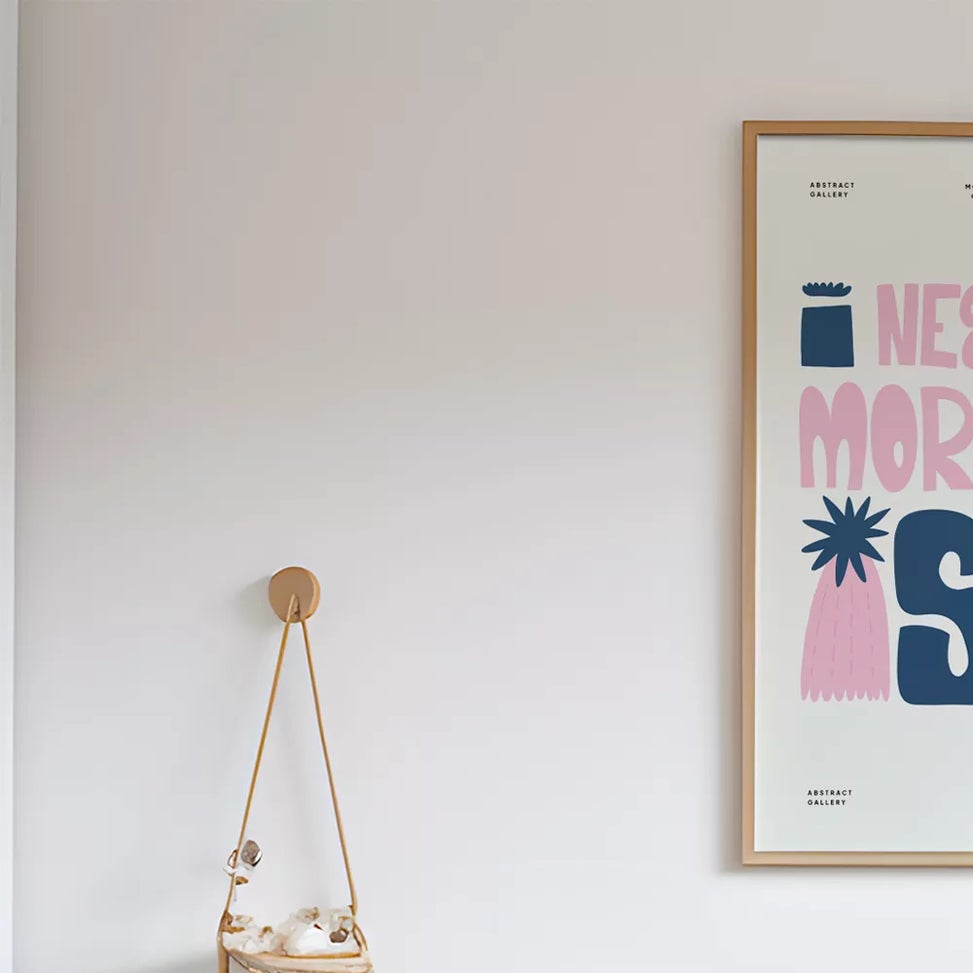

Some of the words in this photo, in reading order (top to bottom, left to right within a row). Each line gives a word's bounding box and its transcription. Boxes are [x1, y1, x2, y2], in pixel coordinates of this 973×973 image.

[809, 181, 855, 190] ABSTRACT
[809, 190, 849, 199] GALLERY
[807, 789, 853, 797] ABSTRACT
[806, 798, 847, 807] GALLERY
